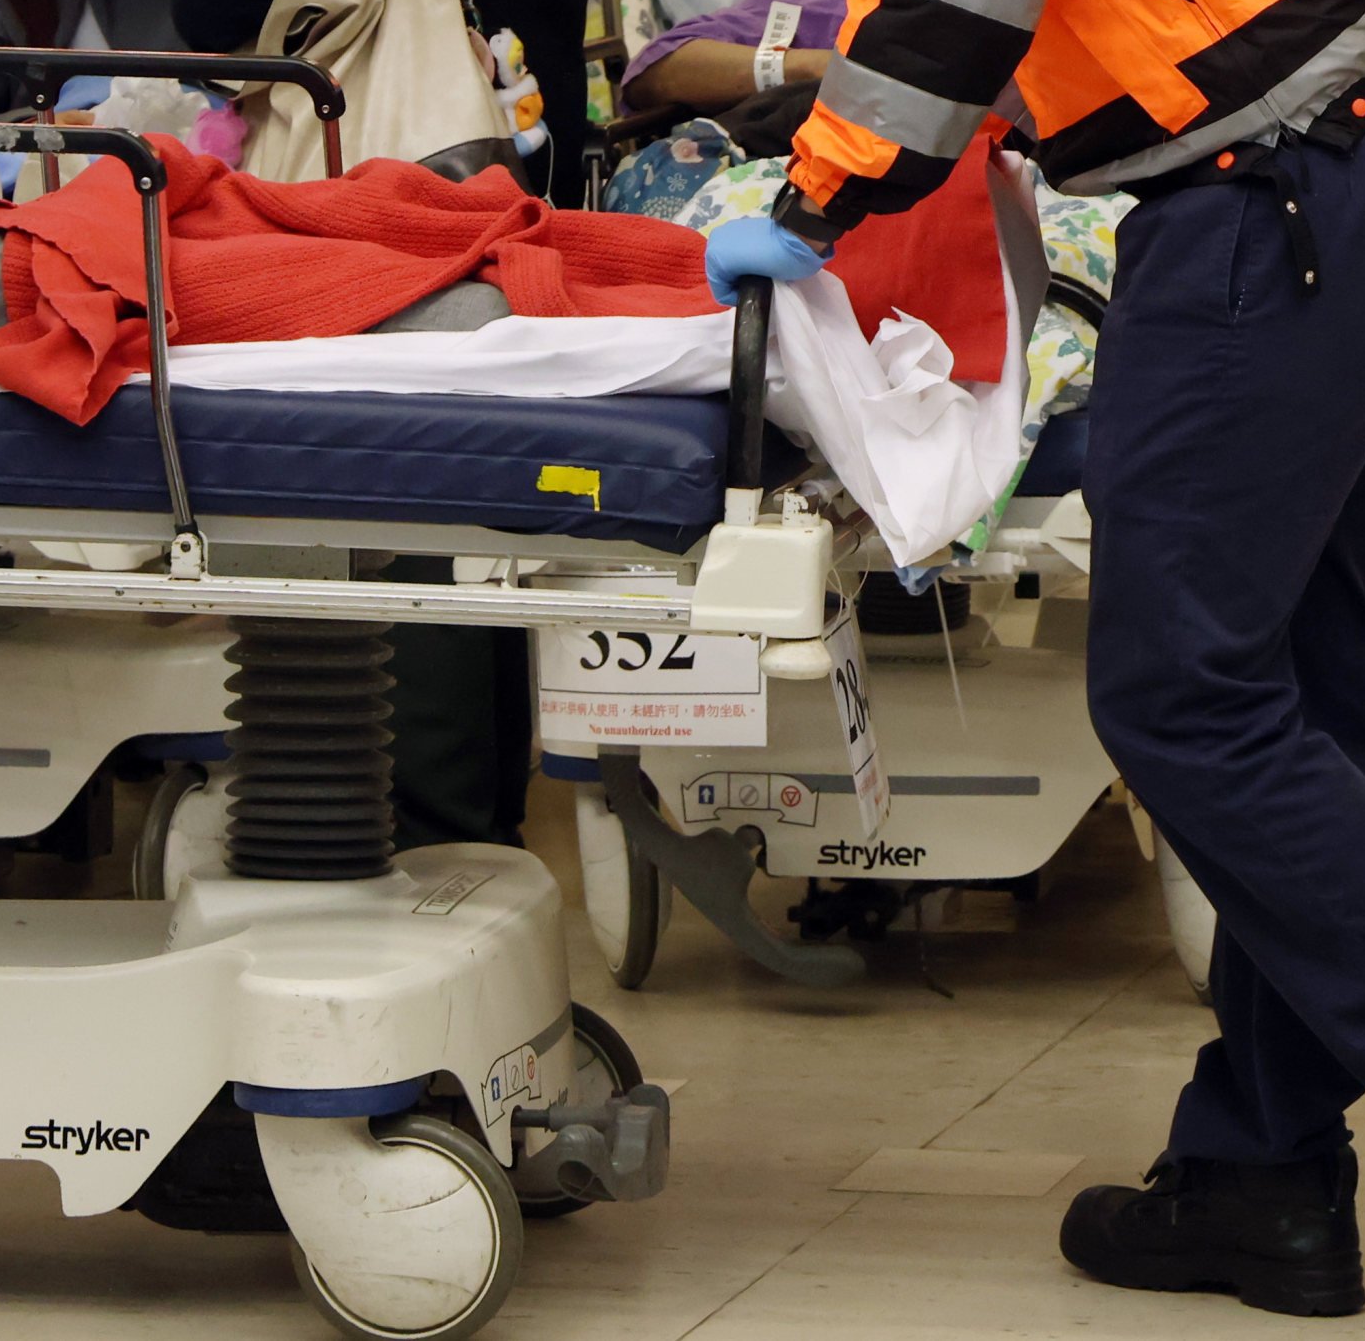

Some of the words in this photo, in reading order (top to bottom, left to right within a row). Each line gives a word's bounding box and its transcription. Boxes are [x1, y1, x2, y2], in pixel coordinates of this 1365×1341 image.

[589, 723, 602, 735] No
[604, 724, 671, 736] unauthorized
[674, 727, 693, 736] use
[817, 840, 927, 869] stryker
[21, 1117, 151, 1156] stryker
